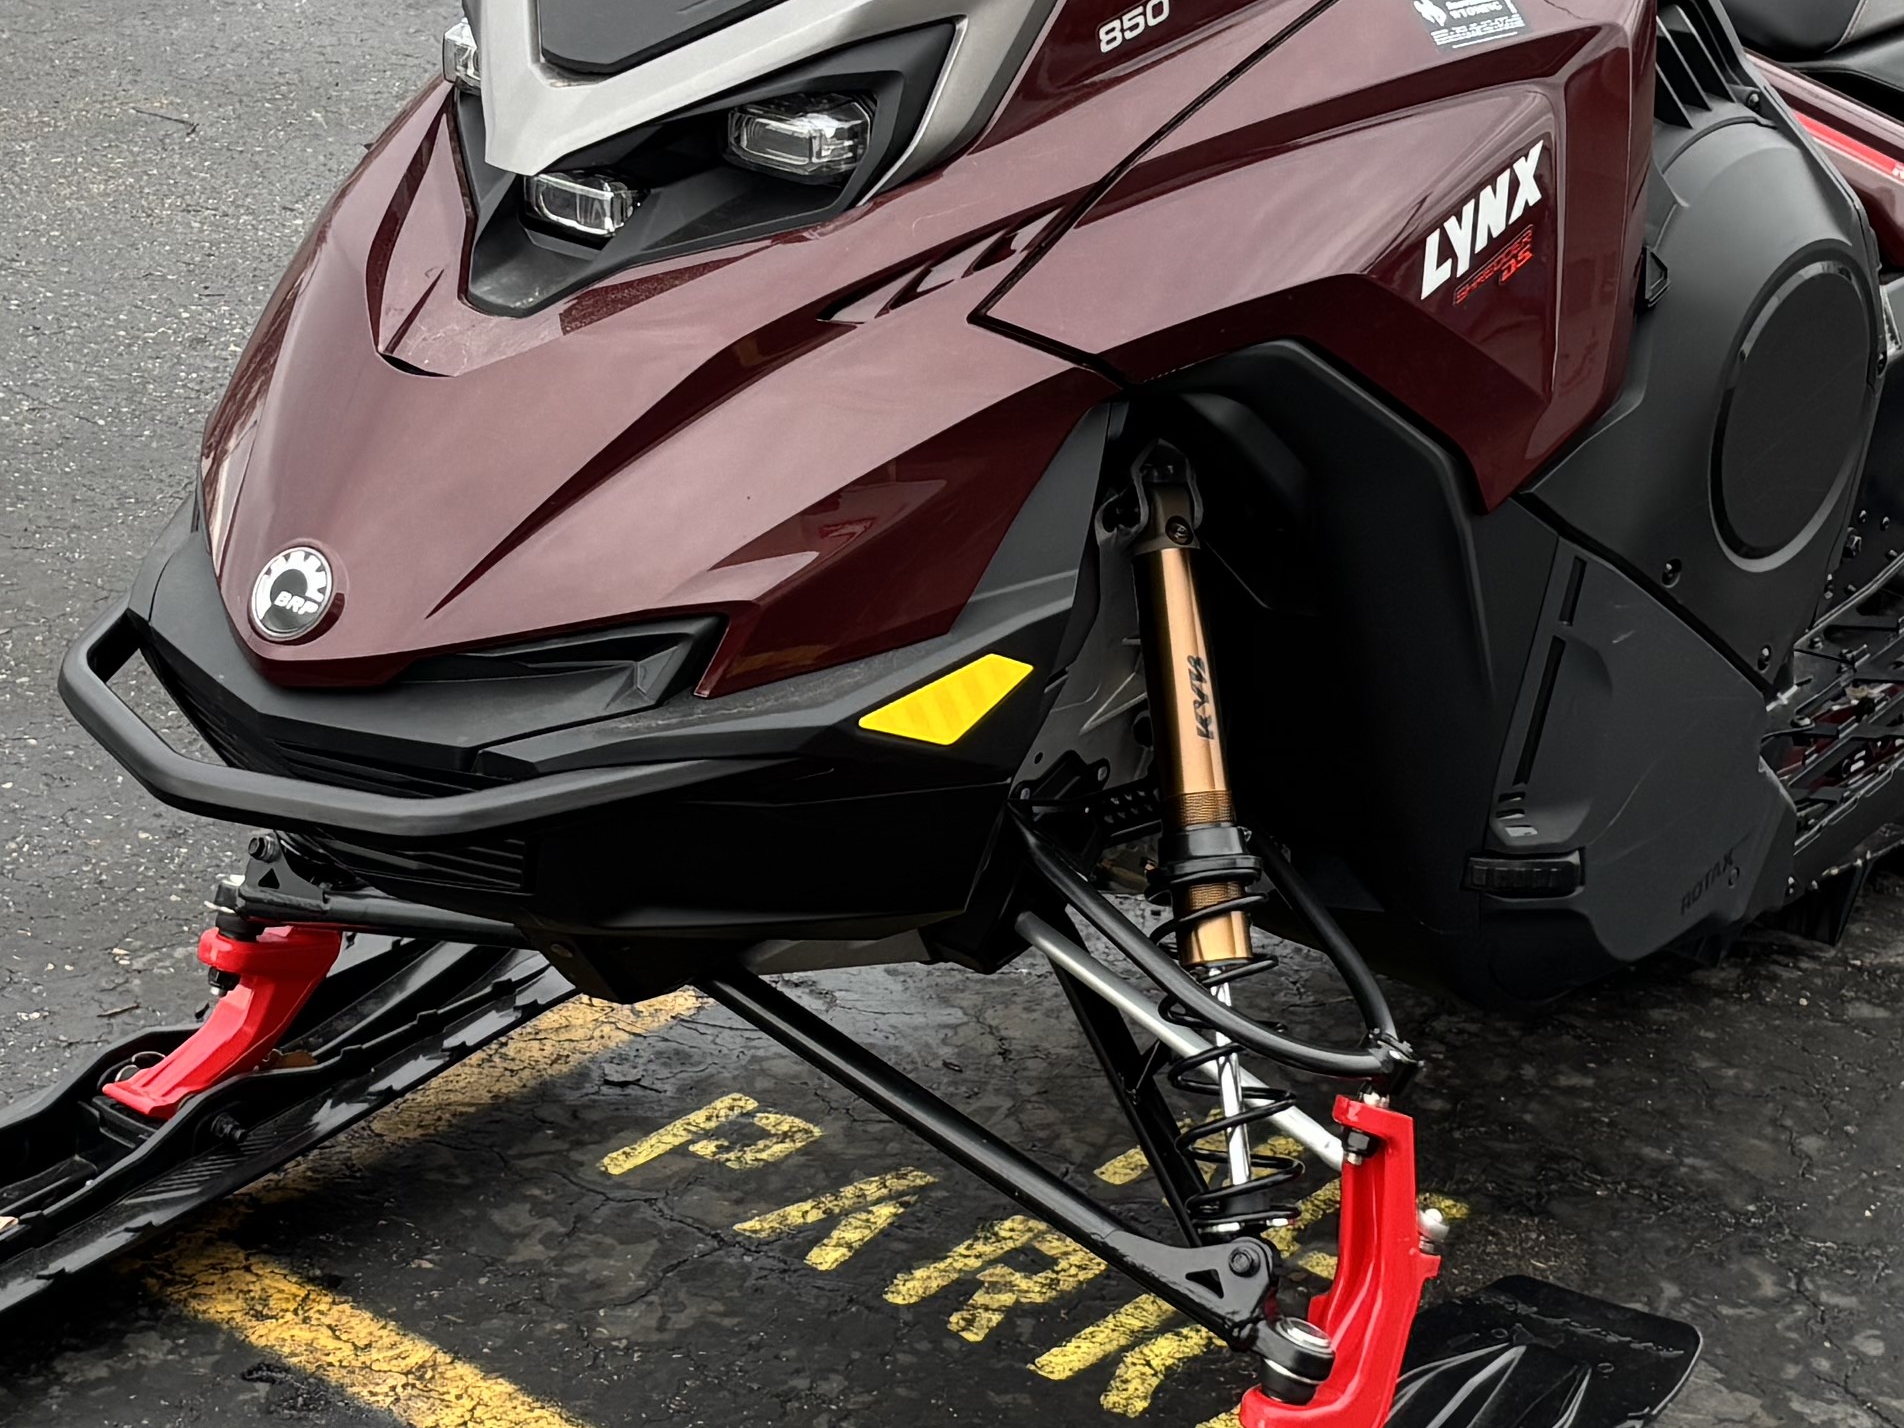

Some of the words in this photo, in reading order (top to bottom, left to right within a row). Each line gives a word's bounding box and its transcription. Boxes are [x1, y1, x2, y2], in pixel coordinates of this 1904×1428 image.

[1421, 139, 1544, 300] LYNX
[274, 591, 318, 615] BRP
[1680, 847, 1734, 916] ROTAX
